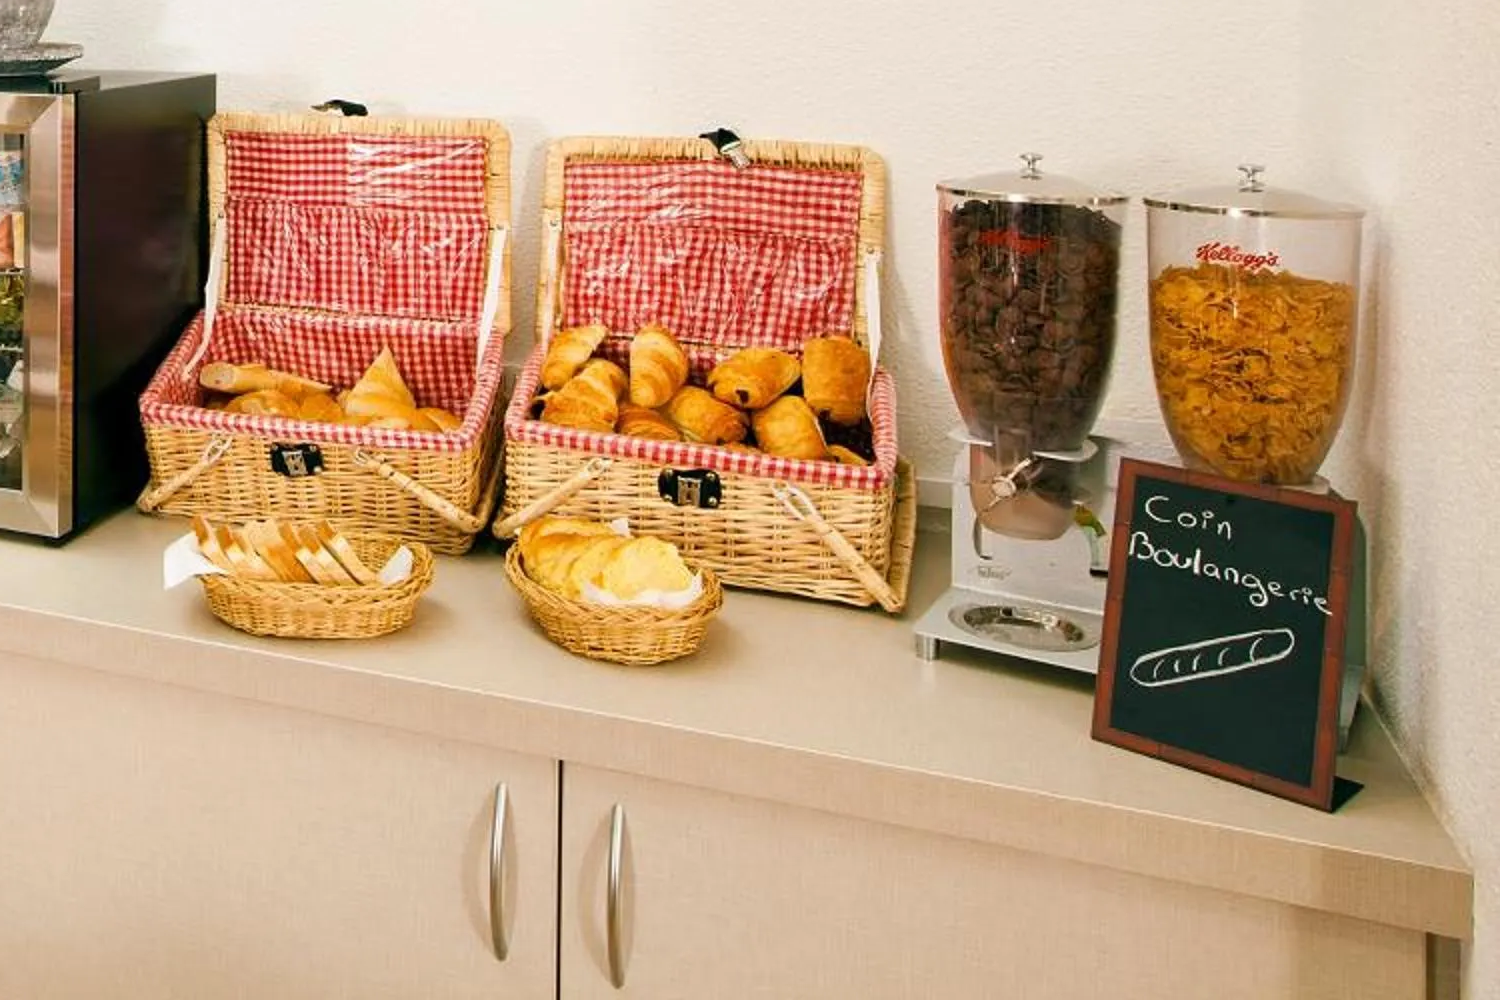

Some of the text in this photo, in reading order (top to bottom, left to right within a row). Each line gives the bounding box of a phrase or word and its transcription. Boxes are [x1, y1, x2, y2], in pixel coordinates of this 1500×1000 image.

[1196, 241, 1280, 270] Kellogg's
[1145, 495, 1232, 541] Coin
[1128, 531, 1334, 617] Boulangerie
